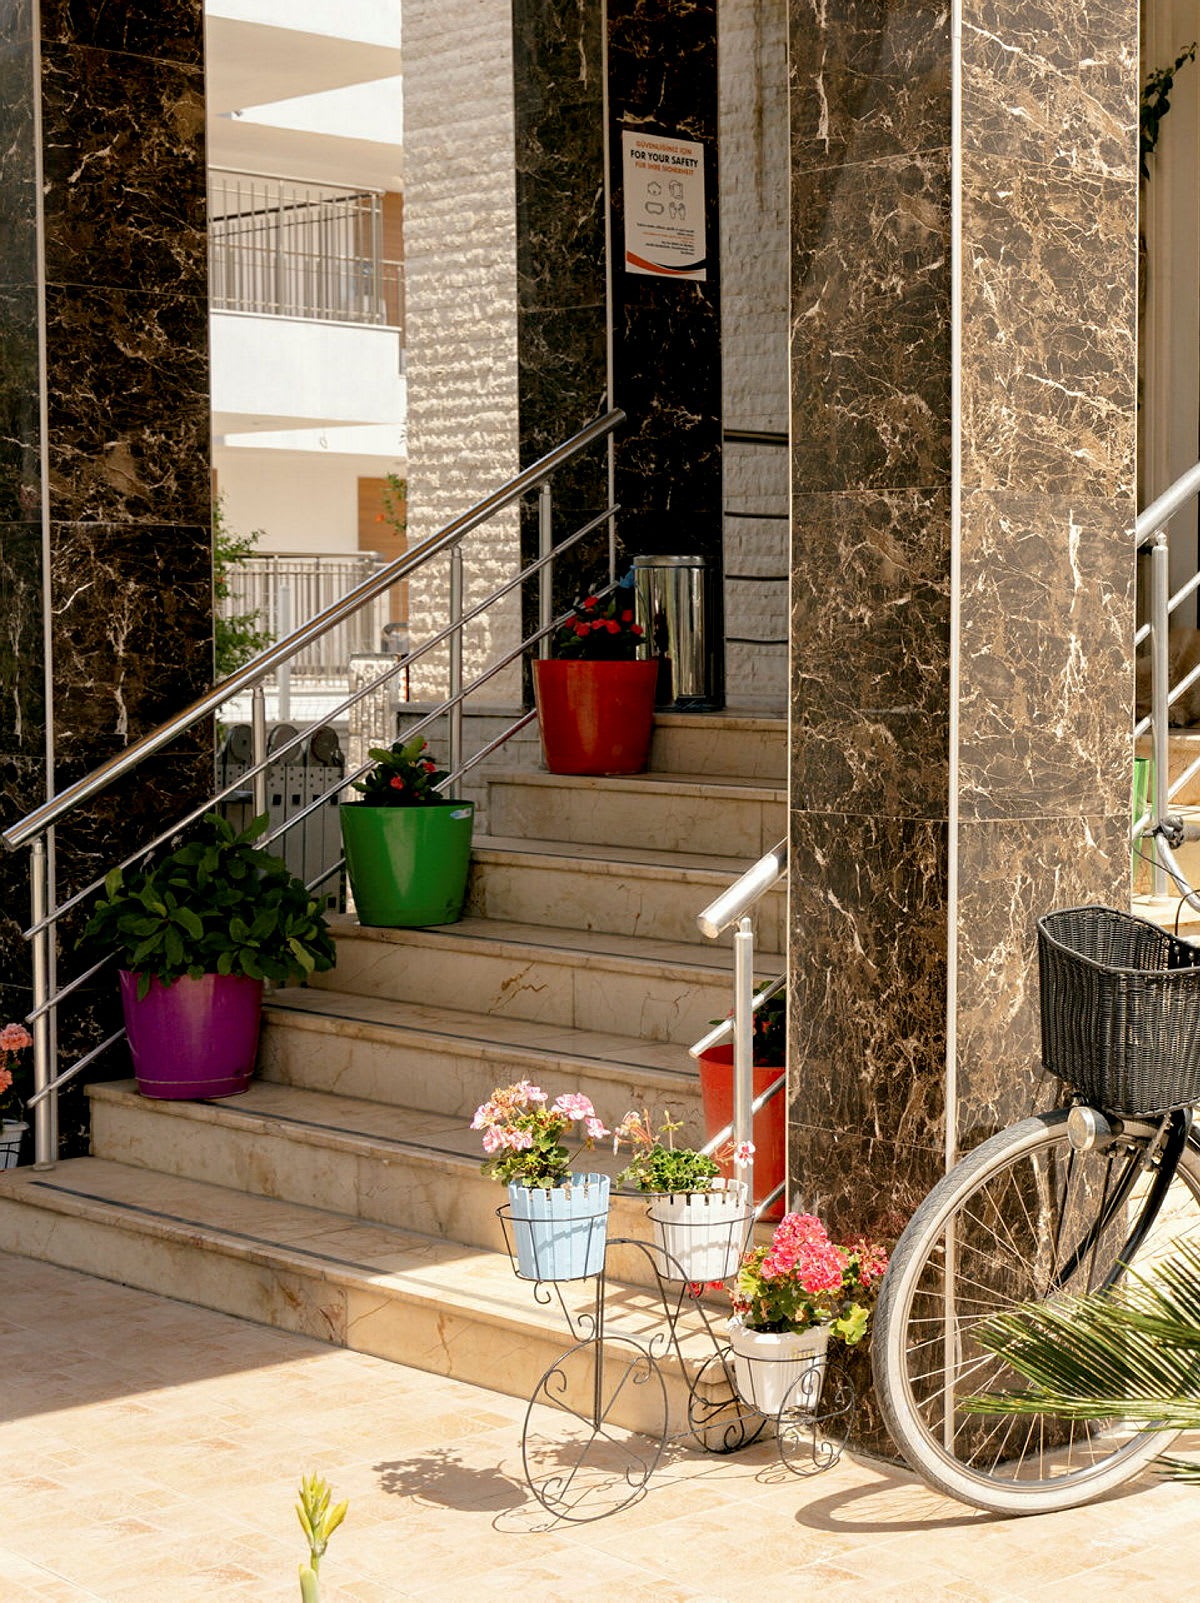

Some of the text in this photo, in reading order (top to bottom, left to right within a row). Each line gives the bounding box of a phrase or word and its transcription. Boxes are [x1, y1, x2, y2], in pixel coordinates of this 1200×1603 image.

[630, 149, 699, 167] FOR YOUR SAFETY
